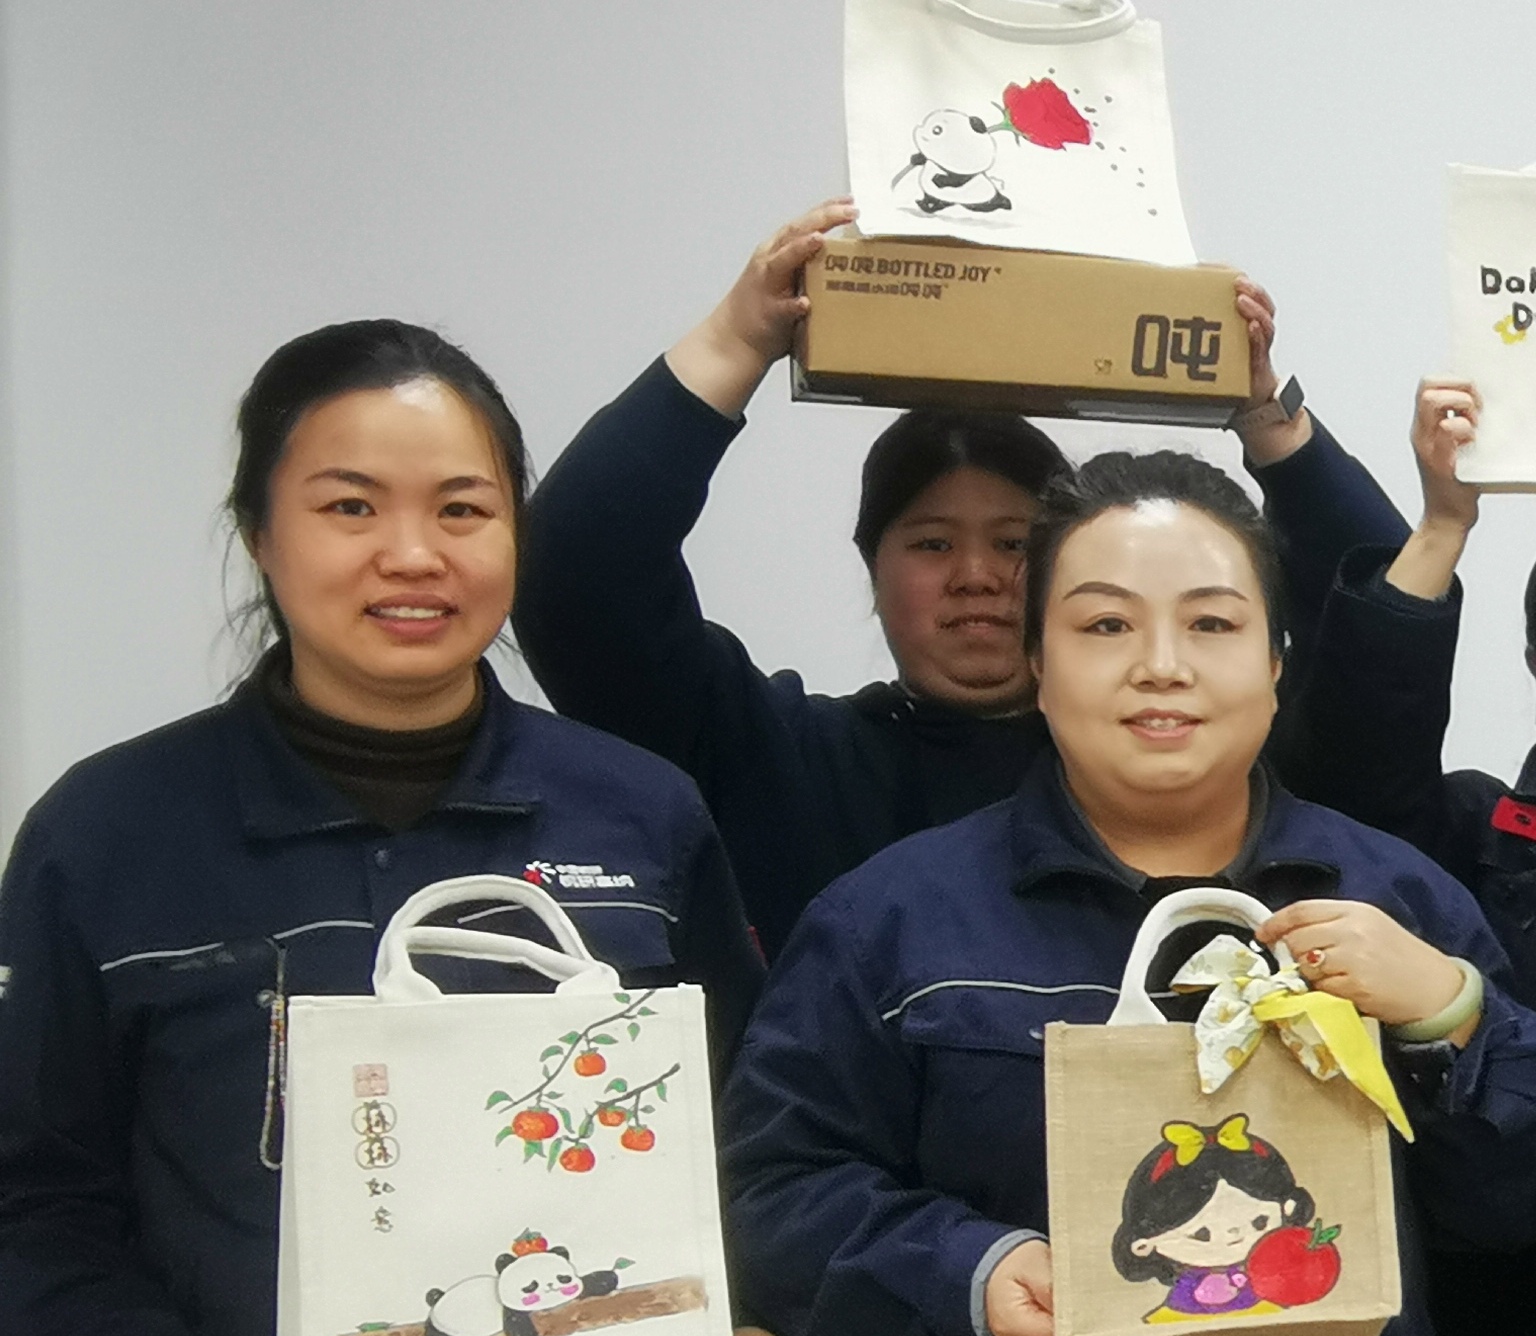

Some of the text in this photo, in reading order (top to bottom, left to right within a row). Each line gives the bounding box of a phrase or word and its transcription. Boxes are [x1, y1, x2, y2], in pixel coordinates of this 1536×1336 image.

[876, 257, 956, 280] BOTTLED
[957, 264, 991, 283] JOY
[1131, 314, 1222, 382] 吨
